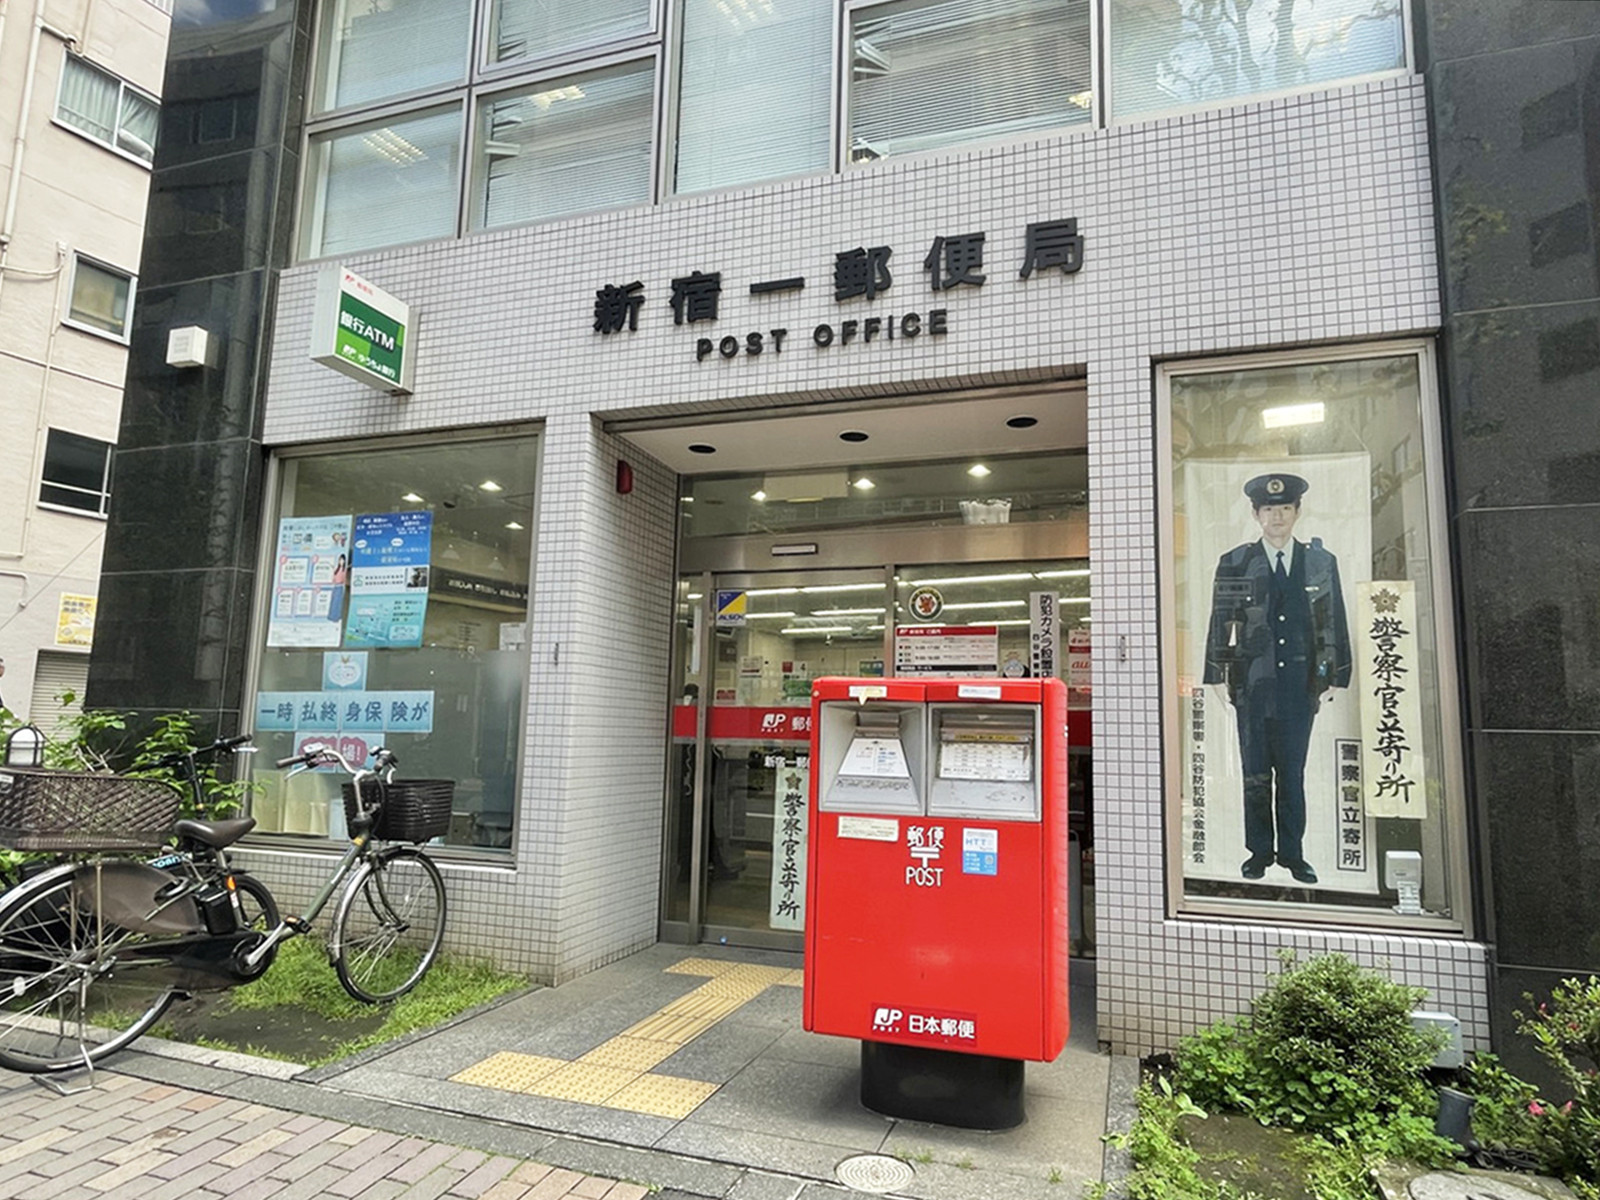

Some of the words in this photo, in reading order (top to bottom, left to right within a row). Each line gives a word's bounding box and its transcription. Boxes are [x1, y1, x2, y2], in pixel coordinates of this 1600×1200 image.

[593, 217, 1084, 334] 新宿一郵便局
[340, 310, 395, 351] 銀行ATM
[697, 329, 787, 362] POST
[813, 309, 948, 347] OFFICE
[260, 701, 430, 722] 一時払終身保険が
[1369, 617, 1416, 803] 警察官立寄り所
[764, 755, 811, 769] 新宿一郵
[1340, 742, 1361, 867] 警察官立寄所
[776, 792, 805, 920] 警察官立寄り所
[907, 826, 944, 849] 郵便
[905, 867, 944, 887] POST
[908, 1014, 975, 1039] 日本郵便
